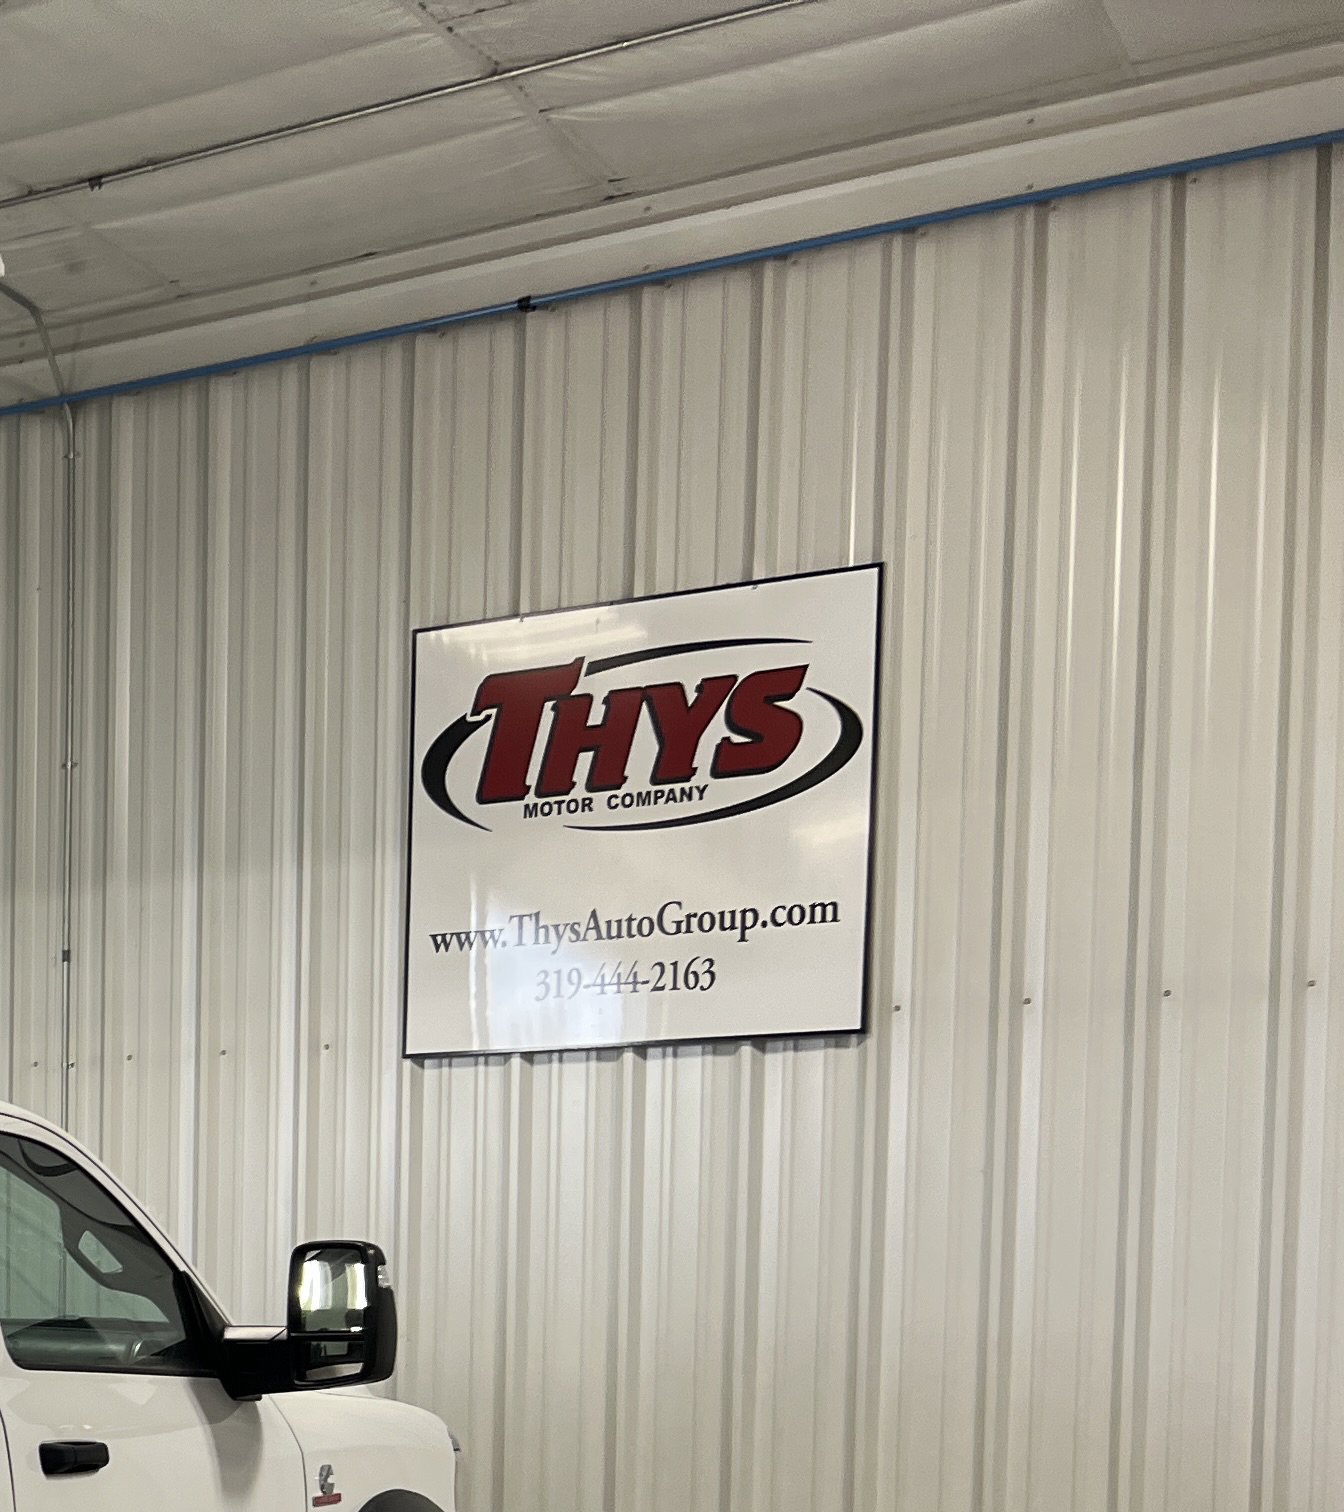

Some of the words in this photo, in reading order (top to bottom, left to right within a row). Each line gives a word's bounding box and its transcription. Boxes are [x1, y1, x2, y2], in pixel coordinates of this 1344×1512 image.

[470, 655, 810, 805] THYS
[522, 797, 593, 819] MOTOR
[606, 785, 710, 811] COMPANY
[428, 899, 841, 955] www.ThysAutoGroup.com
[534, 956, 718, 1002] 319-444-2163
